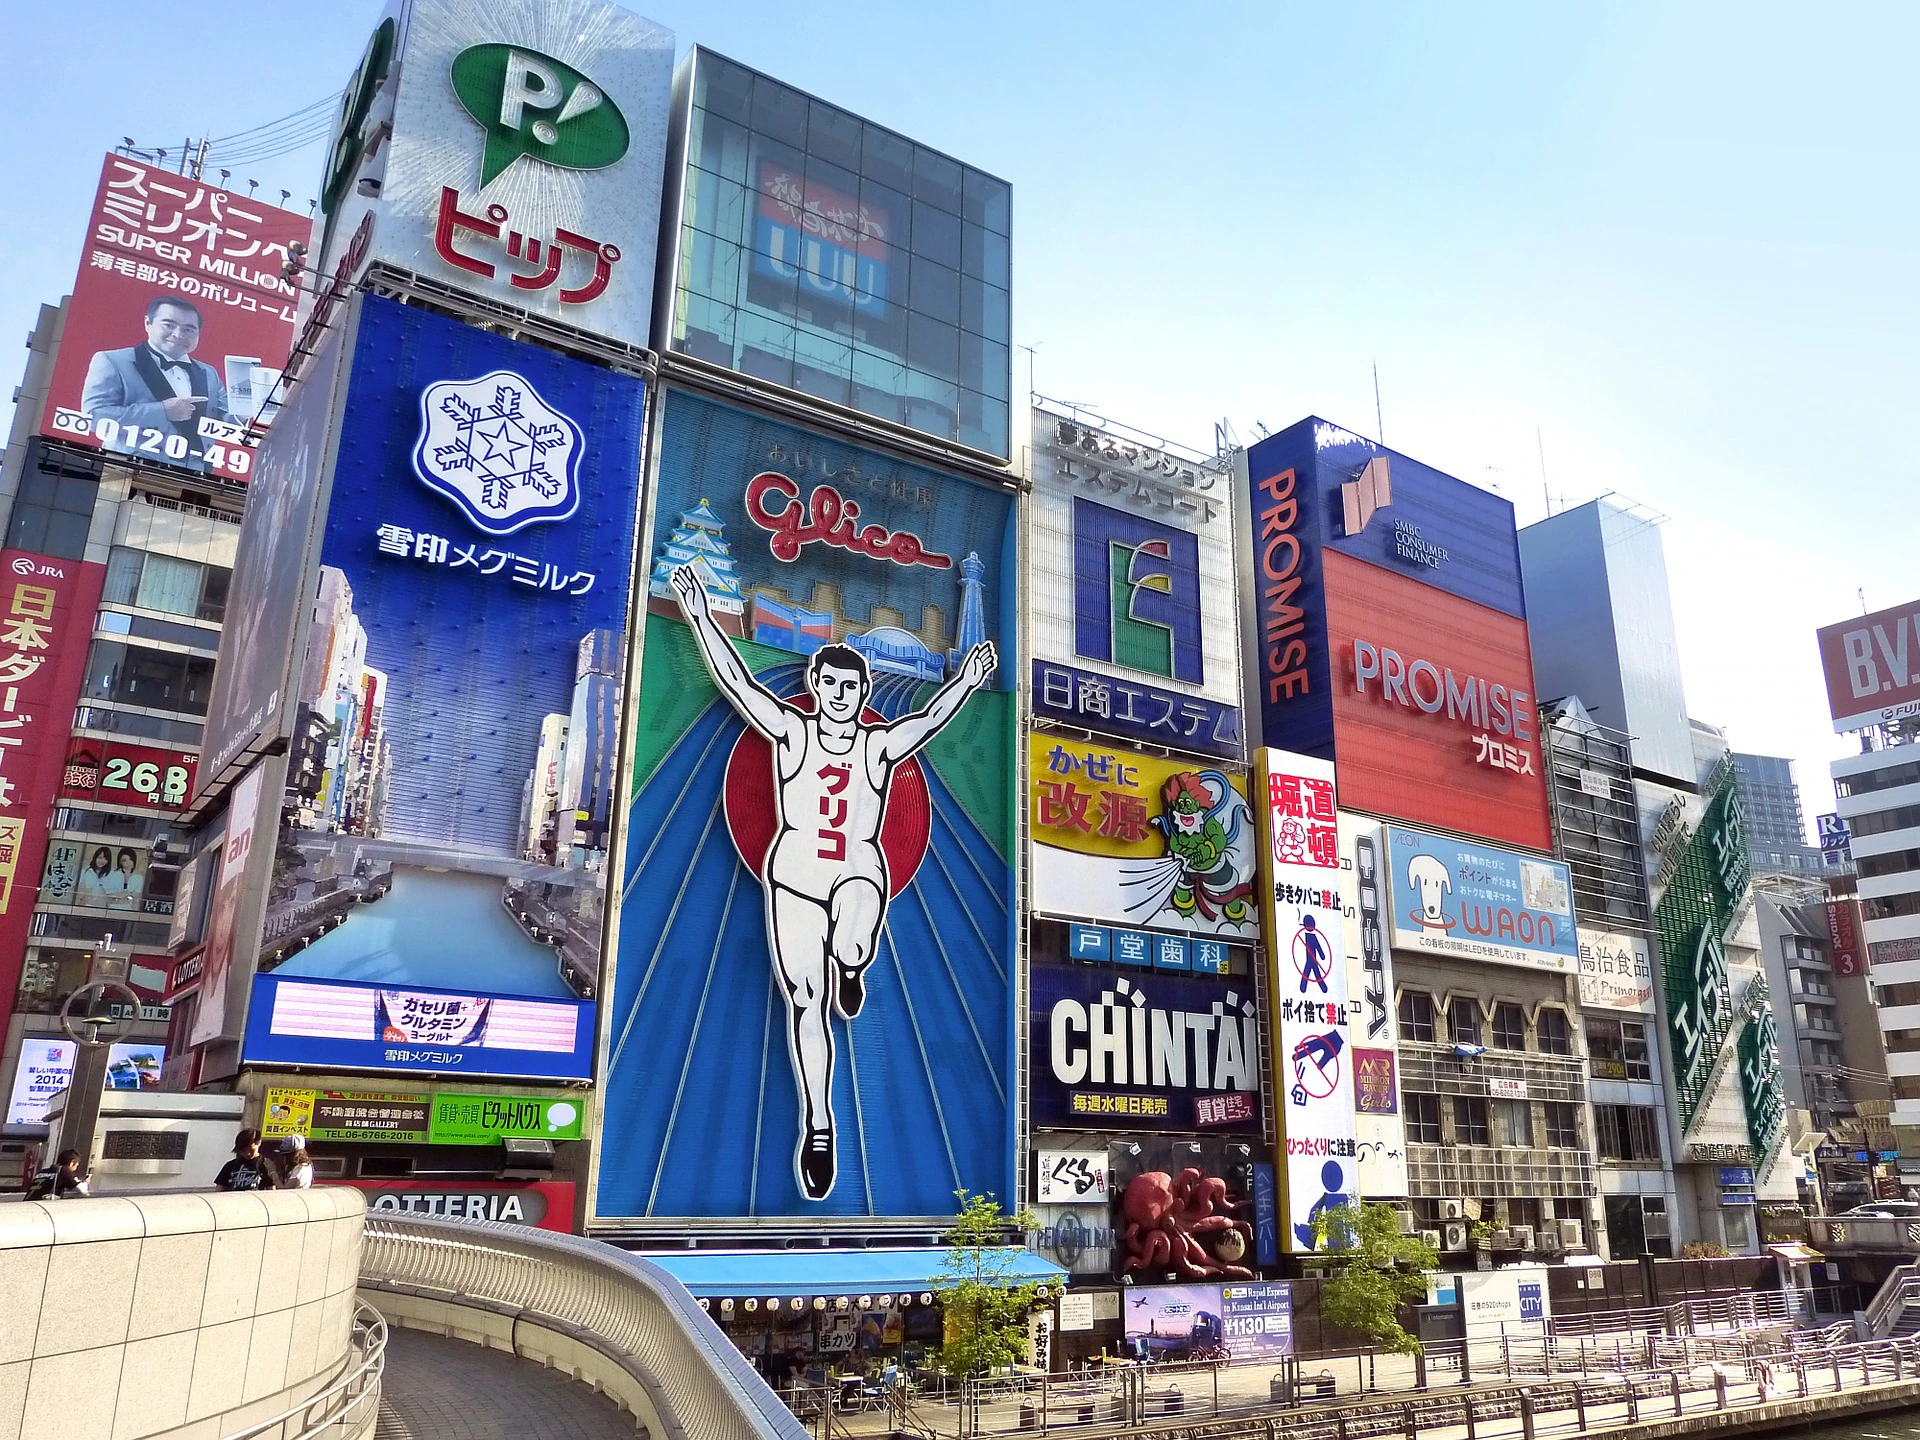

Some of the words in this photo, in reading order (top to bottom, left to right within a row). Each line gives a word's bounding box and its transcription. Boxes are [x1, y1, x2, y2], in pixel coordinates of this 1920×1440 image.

[108, 160, 263, 223] スーパー
[434, 185, 622, 304] ピップ
[96, 223, 192, 265] SUPER
[198, 254, 296, 297] MILLION
[95, 418, 251, 474] 0120-49
[768, 443, 932, 505] おいしさと健康
[1057, 454, 1217, 524] エステムコート
[1394, 518, 1422, 539] SMBC
[376, 523, 596, 595] 雪印メグミルク
[1395, 531, 1449, 562] CONSUMER
[1397, 543, 1440, 570] FINANCE
[36, 566, 64, 579] JRA
[1259, 467, 1309, 703] PROMISE
[1354, 639, 1531, 741] PROMISE
[1044, 668, 1240, 746] 日商エステム
[182, 755, 198, 764] 5F
[1049, 745, 1139, 788] かぜに
[1471, 733, 1535, 777] プロミス
[102, 758, 188, 796] 268
[147, 793, 160, 803] 円
[816, 762, 852, 861] グリコ
[1037, 779, 1150, 842] 改源
[1712, 790, 1745, 872] エイブル
[52, 847, 77, 861] 4F
[1457, 853, 1506, 871] お買物のたびに
[1275, 882, 1341, 911] 歩きタバコ禁止
[1460, 886, 1517, 903] おトクな電子マネー
[1461, 901, 1555, 947] WAON
[1828, 904, 1842, 949] SHIDAX
[1079, 929, 1222, 968] 戸堂歯科
[1840, 953, 1854, 974] 3
[1282, 998, 1347, 1026] ポイ捨て禁止
[1674, 924, 1729, 1074] エイブル
[401, 1013, 467, 1031] グルタミン
[411, 1030, 453, 1042] ヨーグルト
[1051, 977, 1259, 1092] CHINTAI
[384, 1049, 463, 1065] 雪印メグミルク
[35, 1075, 64, 1085] 2014
[1361, 1075, 1390, 1085] MILLION
[1363, 1084, 1388, 1094] RACER
[481, 1101, 541, 1130] ピタットハウス
[1073, 1094, 1168, 1115] 毎週水曜日発売
[1197, 1097, 1227, 1124] 賃貸
[1227, 1105, 1253, 1119] ニュース
[1360, 1094, 1392, 1110] Girls
[1286, 1137, 1356, 1157] ひったくりに注意
[1051, 1157, 1095, 1194] くくる
[1246, 1163, 1253, 1191] 2F
[1232, 1301, 1253, 1312] Kansai
[1267, 1300, 1290, 1312] Airport
[1248, 1287, 1266, 1300] Rapid
[1267, 1286, 1289, 1300] Express
[1520, 1296, 1542, 1312] CITY
[820, 1332, 857, 1350] 串カツ
